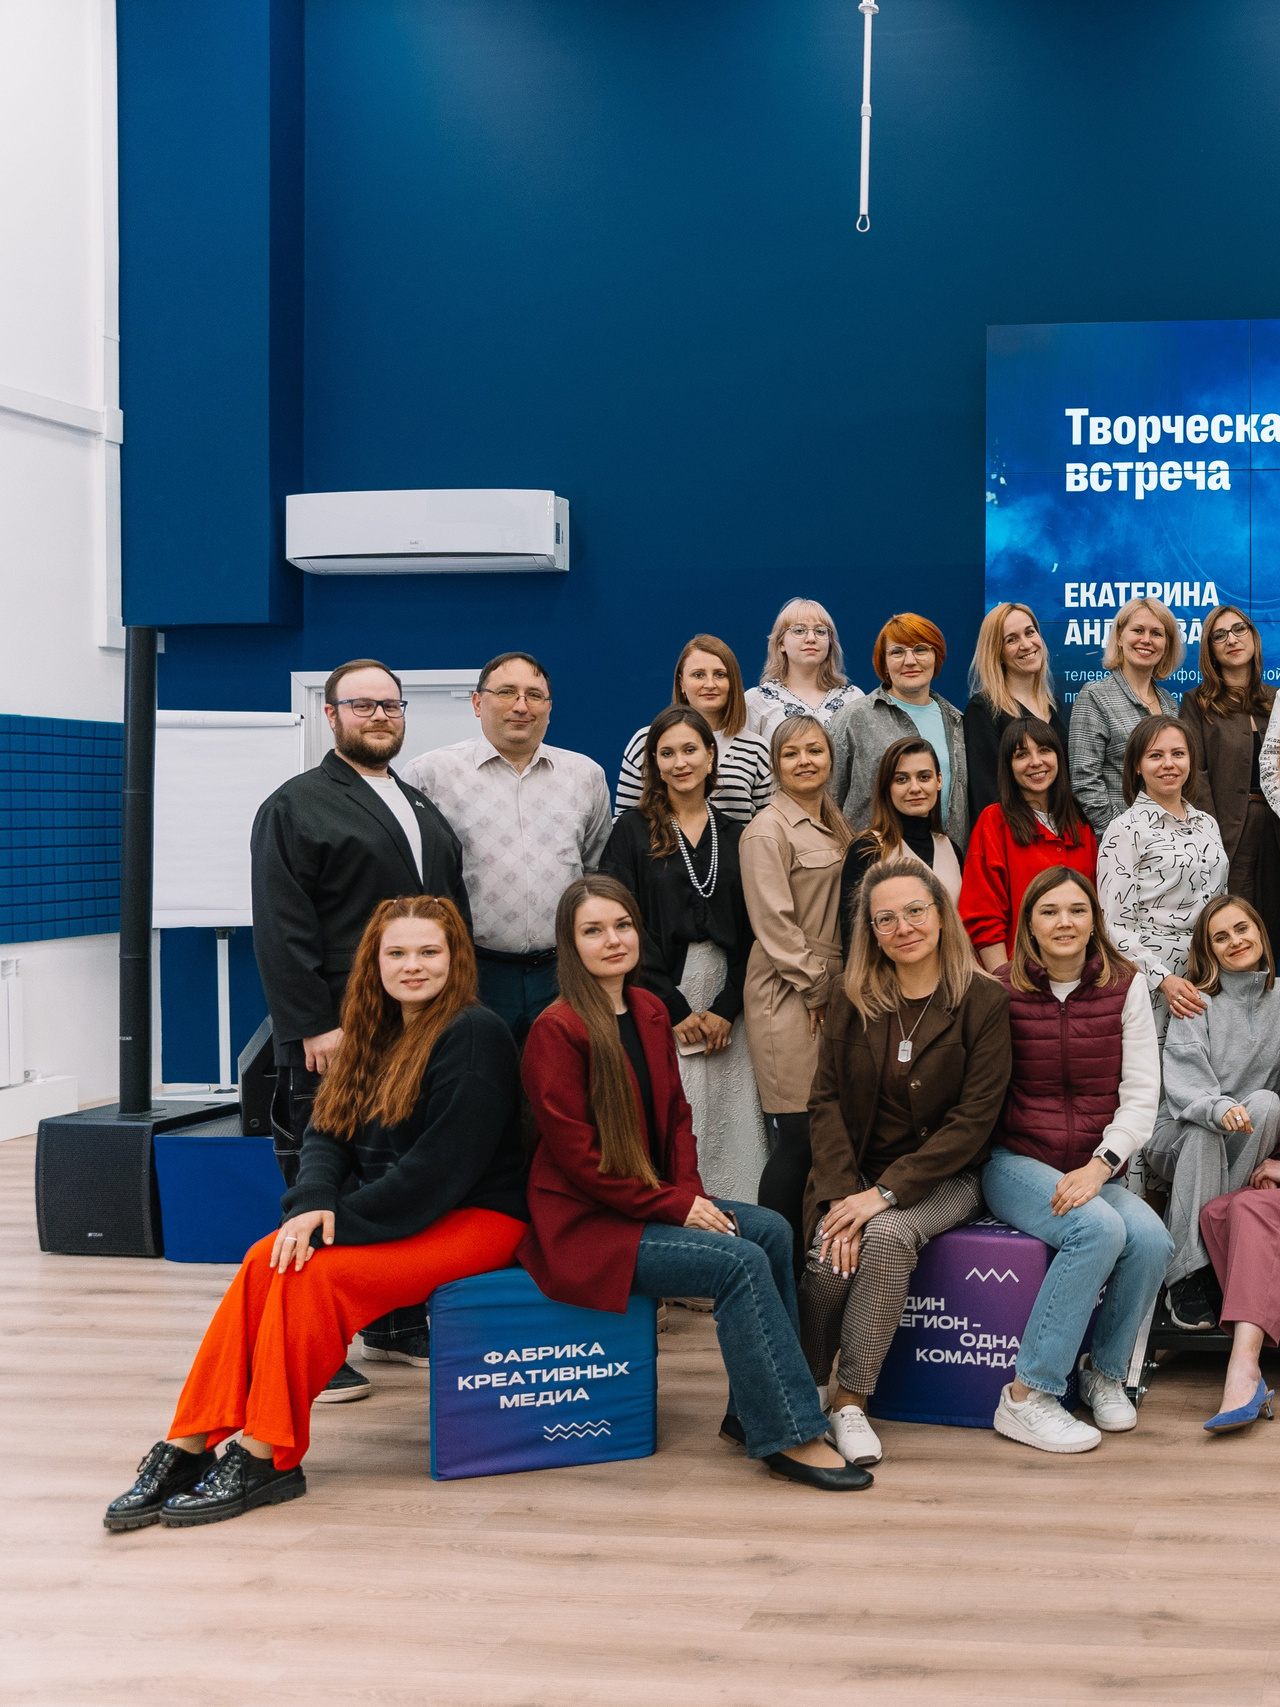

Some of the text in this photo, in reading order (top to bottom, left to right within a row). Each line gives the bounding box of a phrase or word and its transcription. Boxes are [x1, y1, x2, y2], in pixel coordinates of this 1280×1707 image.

[1066, 460, 1231, 500] встреча
[1064, 581, 1219, 608] ЕКАТЕРИНА
[903, 1296, 945, 1311] ДИН
[899, 1314, 968, 1330] ЕГИОН
[959, 1333, 1021, 1350] ОДНА
[483, 1342, 605, 1365] ФАБРИКА
[457, 1361, 630, 1391] КРЕАТИВНЫХ
[500, 1387, 590, 1409] МЕДИА
